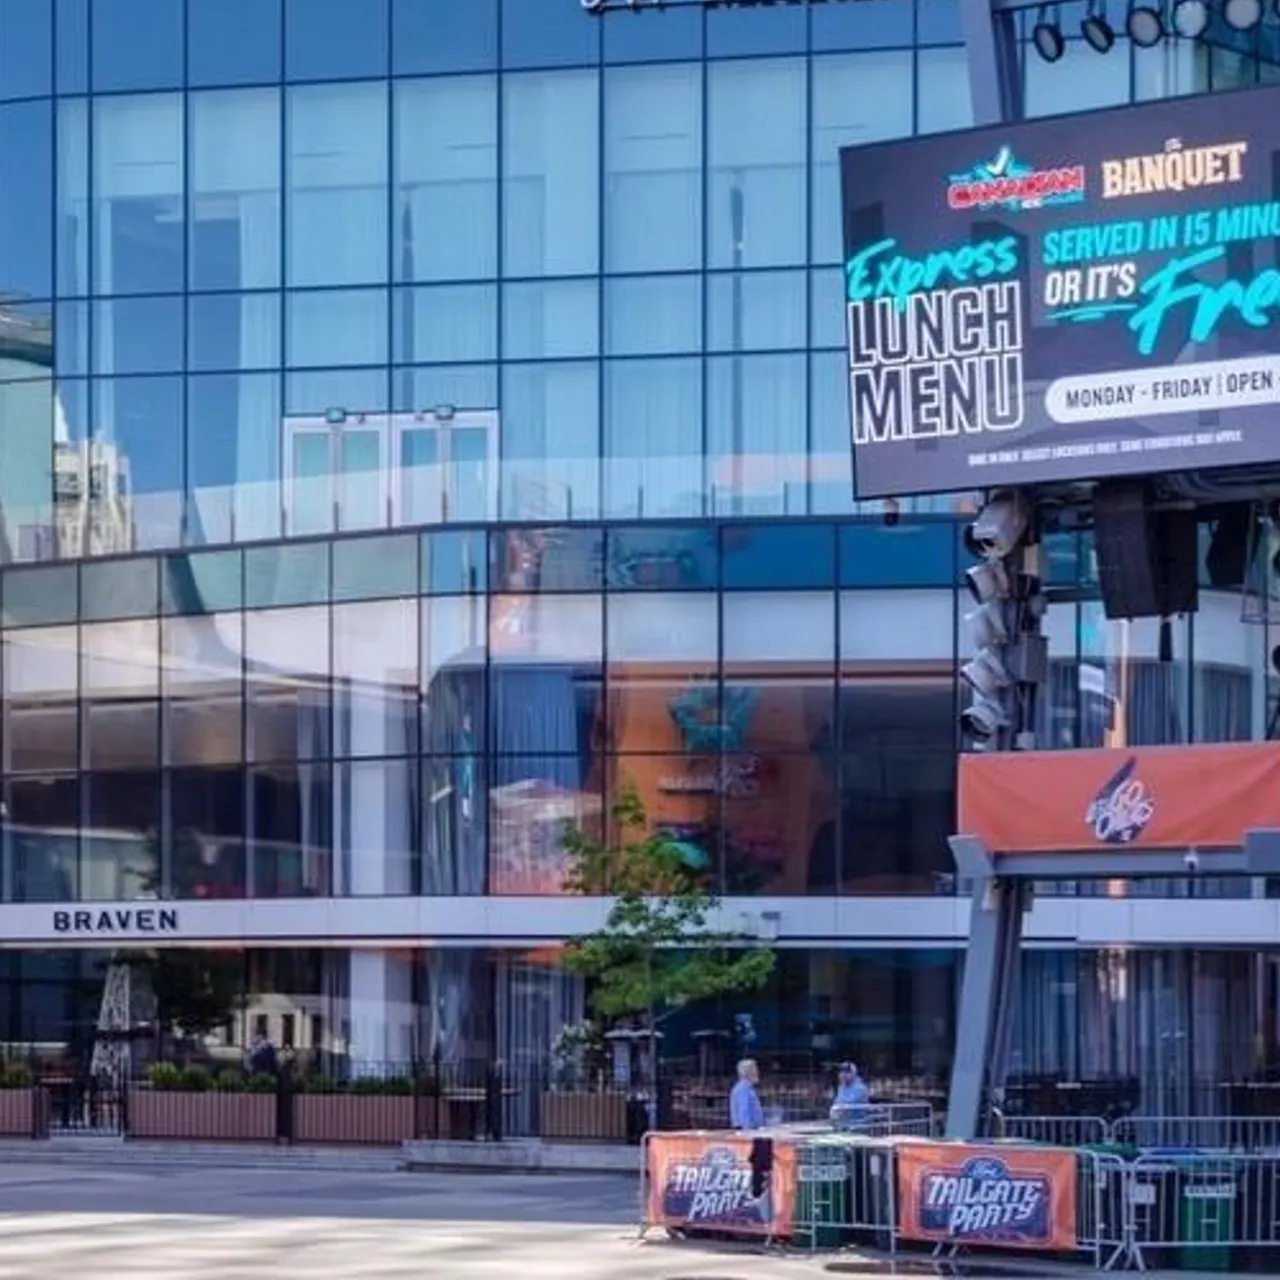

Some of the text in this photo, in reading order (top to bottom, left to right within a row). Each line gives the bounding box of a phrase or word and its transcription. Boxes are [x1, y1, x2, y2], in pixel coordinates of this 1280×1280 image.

[1101, 142, 1248, 199] BANQUET
[1043, 221, 1143, 265] SERVED
[1148, 217, 1181, 250] IN
[1184, 211, 1211, 246] 15
[847, 236, 1018, 314] Express
[1044, 262, 1137, 306] OR IT'S
[848, 280, 1023, 368] LUNCH
[851, 352, 1024, 444] MENU
[1065, 384, 1136, 410] MONDAY
[1151, 377, 1212, 401] FRIDAY
[1226, 369, 1273, 394] OPEN
[52, 909, 178, 932] BRAVEN
[926, 1174, 1043, 1204] TAILGATE
[949, 1195, 1039, 1235] PARTY
